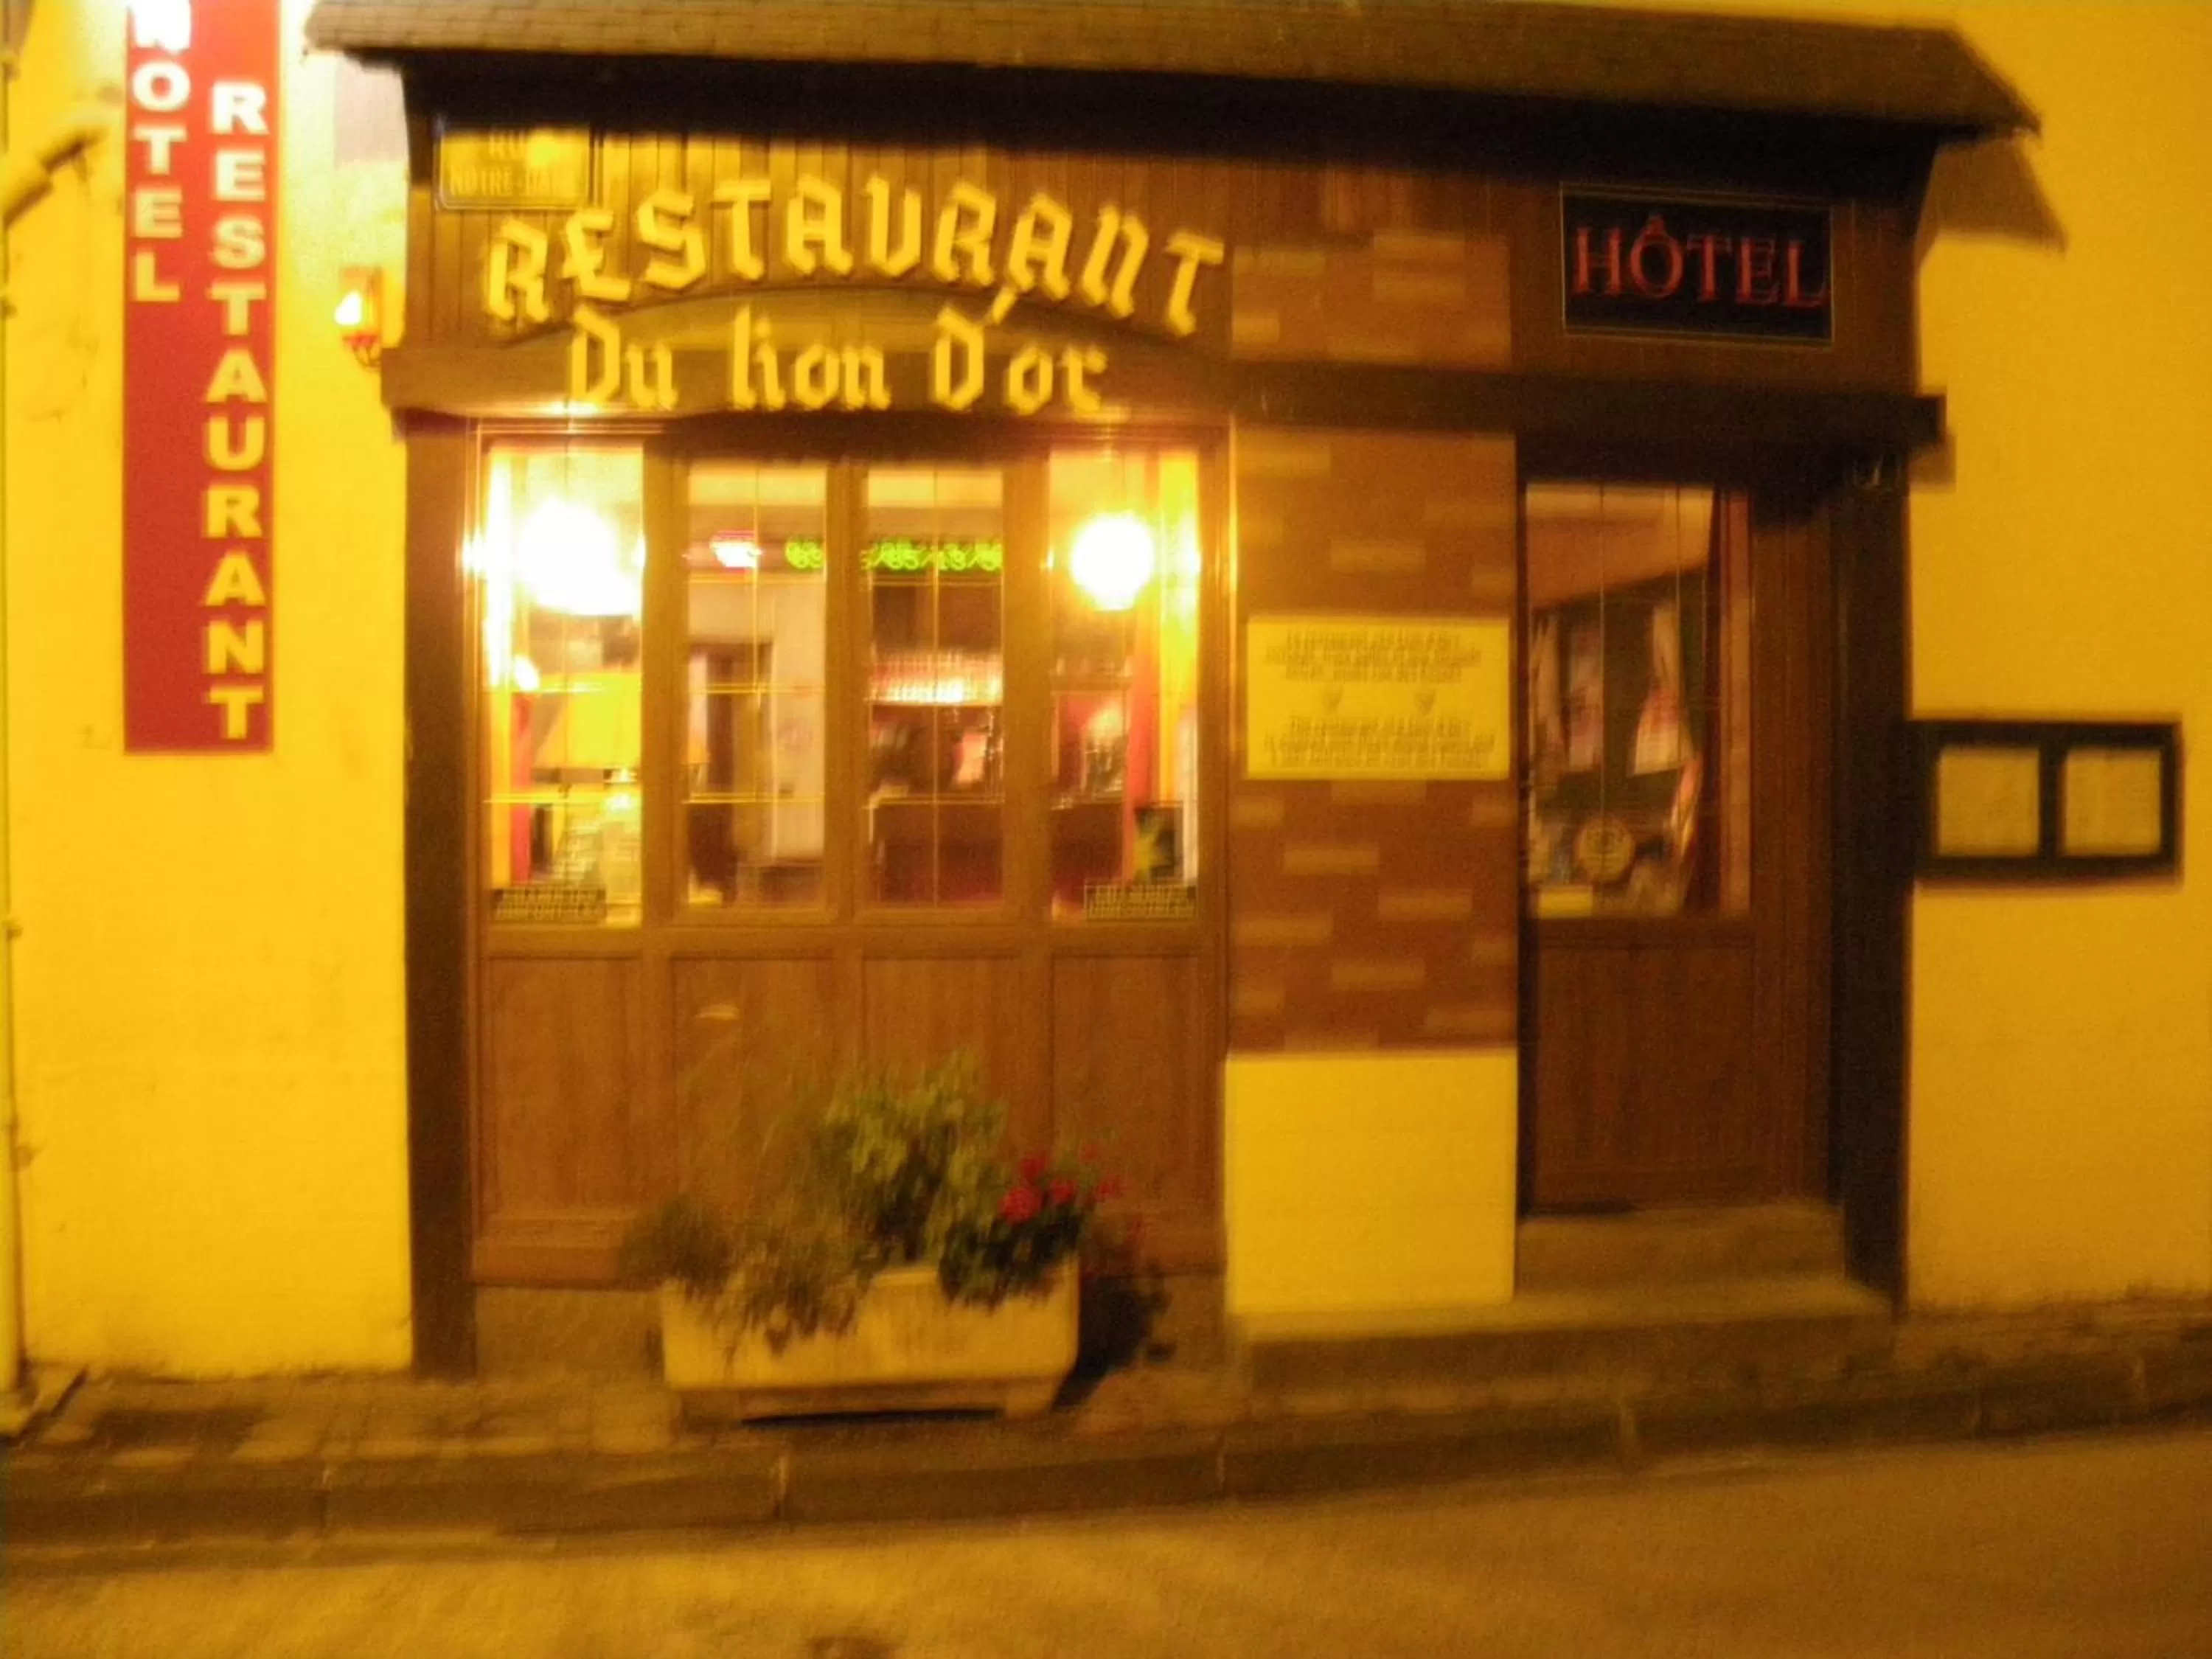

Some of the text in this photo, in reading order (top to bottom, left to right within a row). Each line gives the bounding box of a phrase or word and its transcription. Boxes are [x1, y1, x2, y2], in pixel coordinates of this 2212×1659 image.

[481, 172, 1225, 338] RESTAURANT
[1571, 214, 1832, 308] HÔTEL
[203, 81, 269, 740] RESTAURANT
[570, 304, 678, 411] Du
